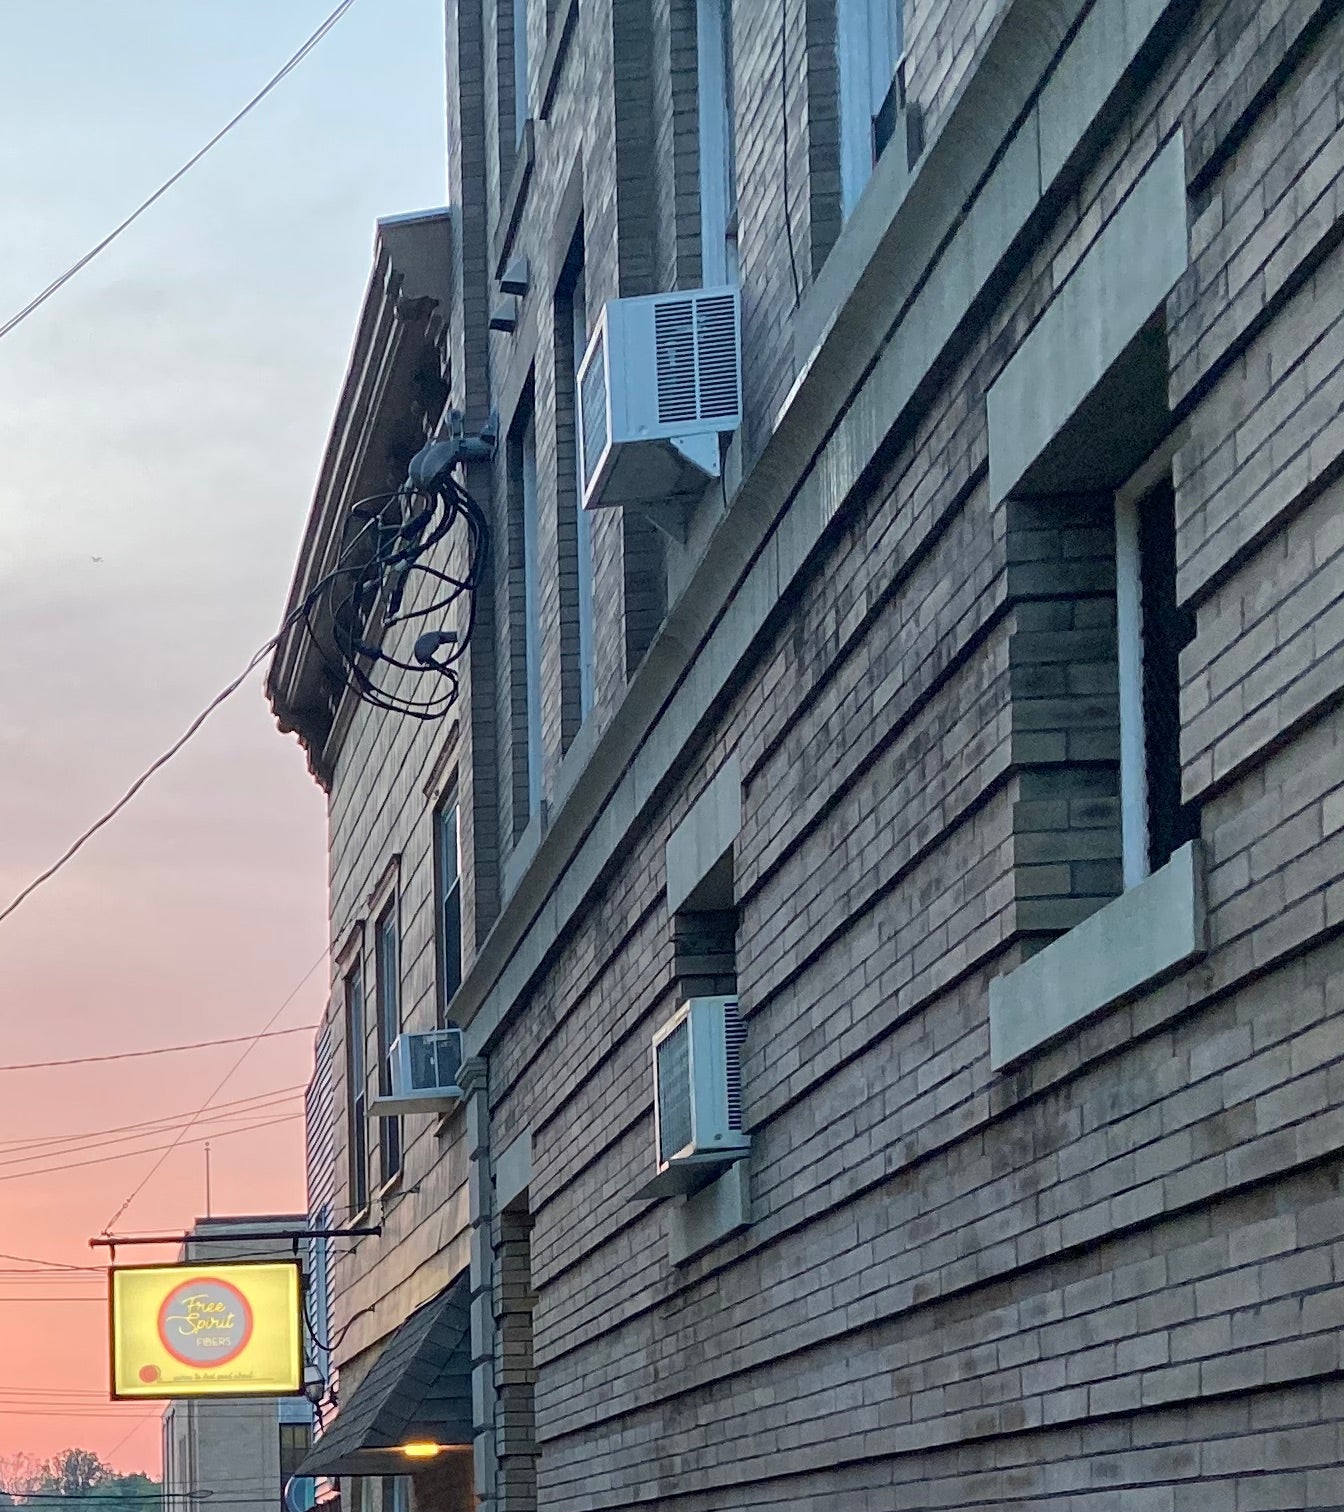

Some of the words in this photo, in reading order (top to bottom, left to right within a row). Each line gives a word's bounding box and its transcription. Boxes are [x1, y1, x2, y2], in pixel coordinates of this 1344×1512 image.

[181, 1294, 225, 1312] Free
[166, 1312, 235, 1335] Spirit
[196, 1337, 231, 1347] FIBERS
